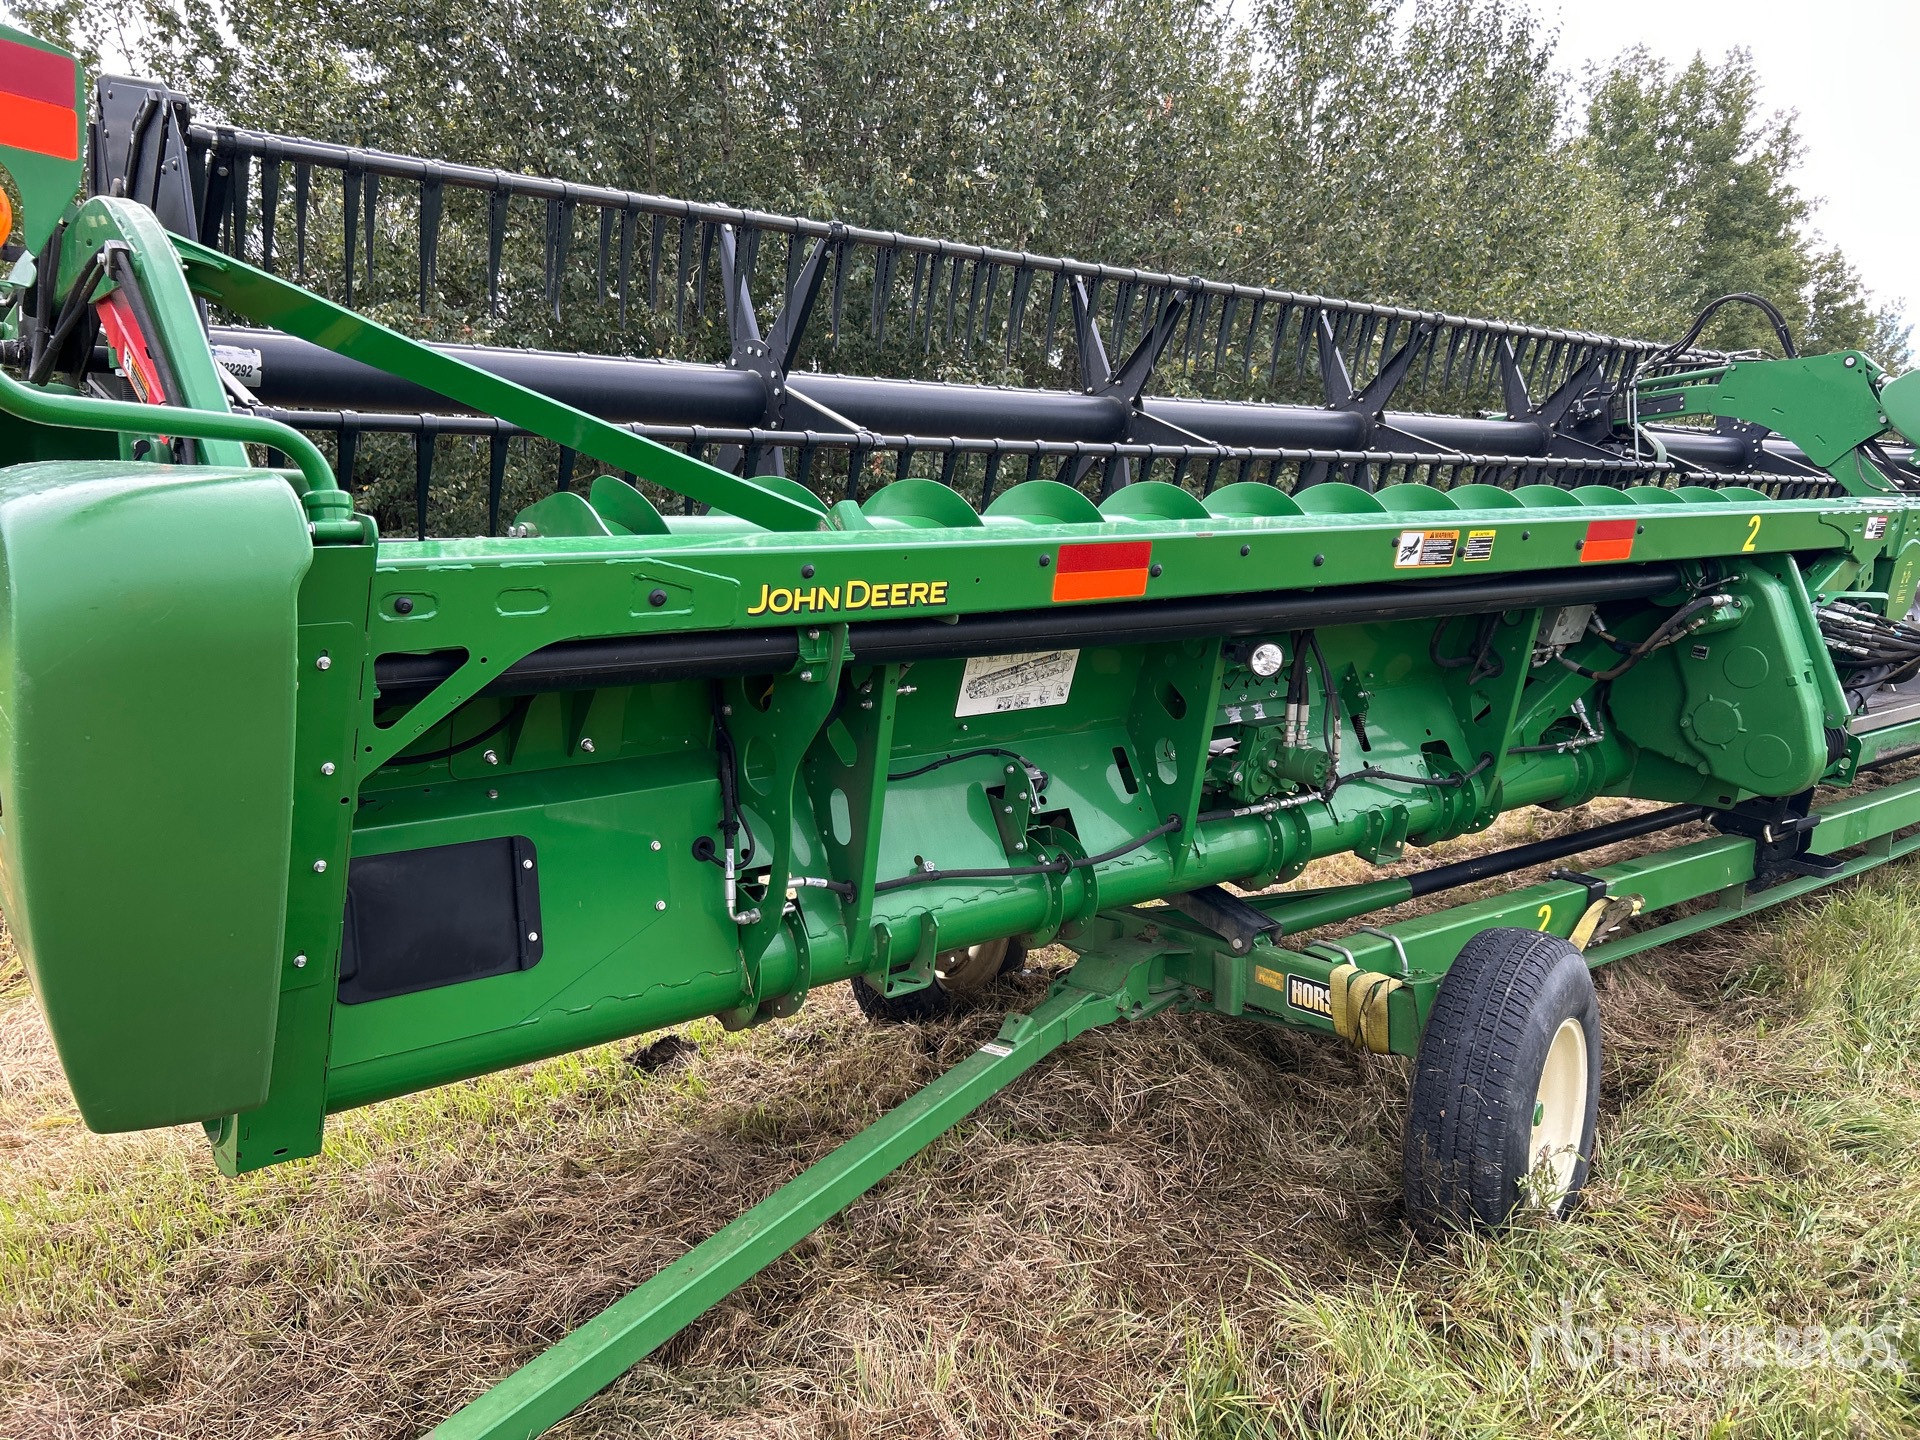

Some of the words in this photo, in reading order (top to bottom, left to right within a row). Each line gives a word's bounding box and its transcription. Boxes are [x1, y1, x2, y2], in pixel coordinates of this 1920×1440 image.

[220, 361, 253, 378] 32292
[1741, 514, 1761, 552] 2
[747, 584, 842, 616] JOHN
[846, 579, 949, 610] DEERE
[1537, 904, 1552, 932] 2
